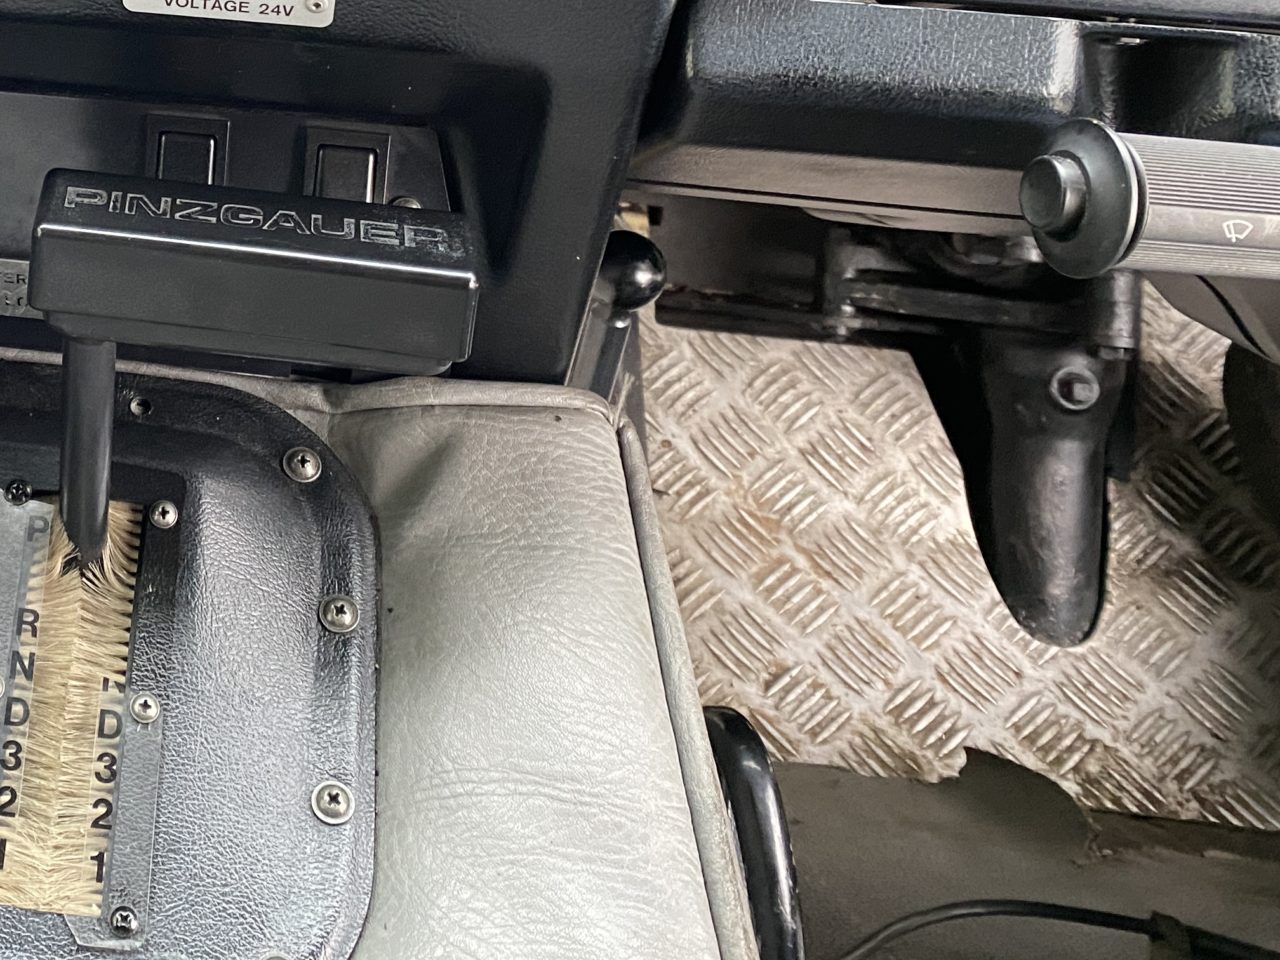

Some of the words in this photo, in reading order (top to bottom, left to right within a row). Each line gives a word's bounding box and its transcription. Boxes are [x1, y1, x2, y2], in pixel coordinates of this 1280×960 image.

[258, 3, 295, 17] 24V
[63, 186, 460, 254] PINZGAUER
[28, 515, 50, 541] P
[16, 607, 40, 638] R
[9, 650, 35, 682] N
[4, 696, 30, 727] D
[97, 708, 123, 739] D
[0, 740, 22, 771] 3
[94, 752, 118, 783] 3
[90, 797, 113, 830] 2
[90, 851, 106, 883] 1
